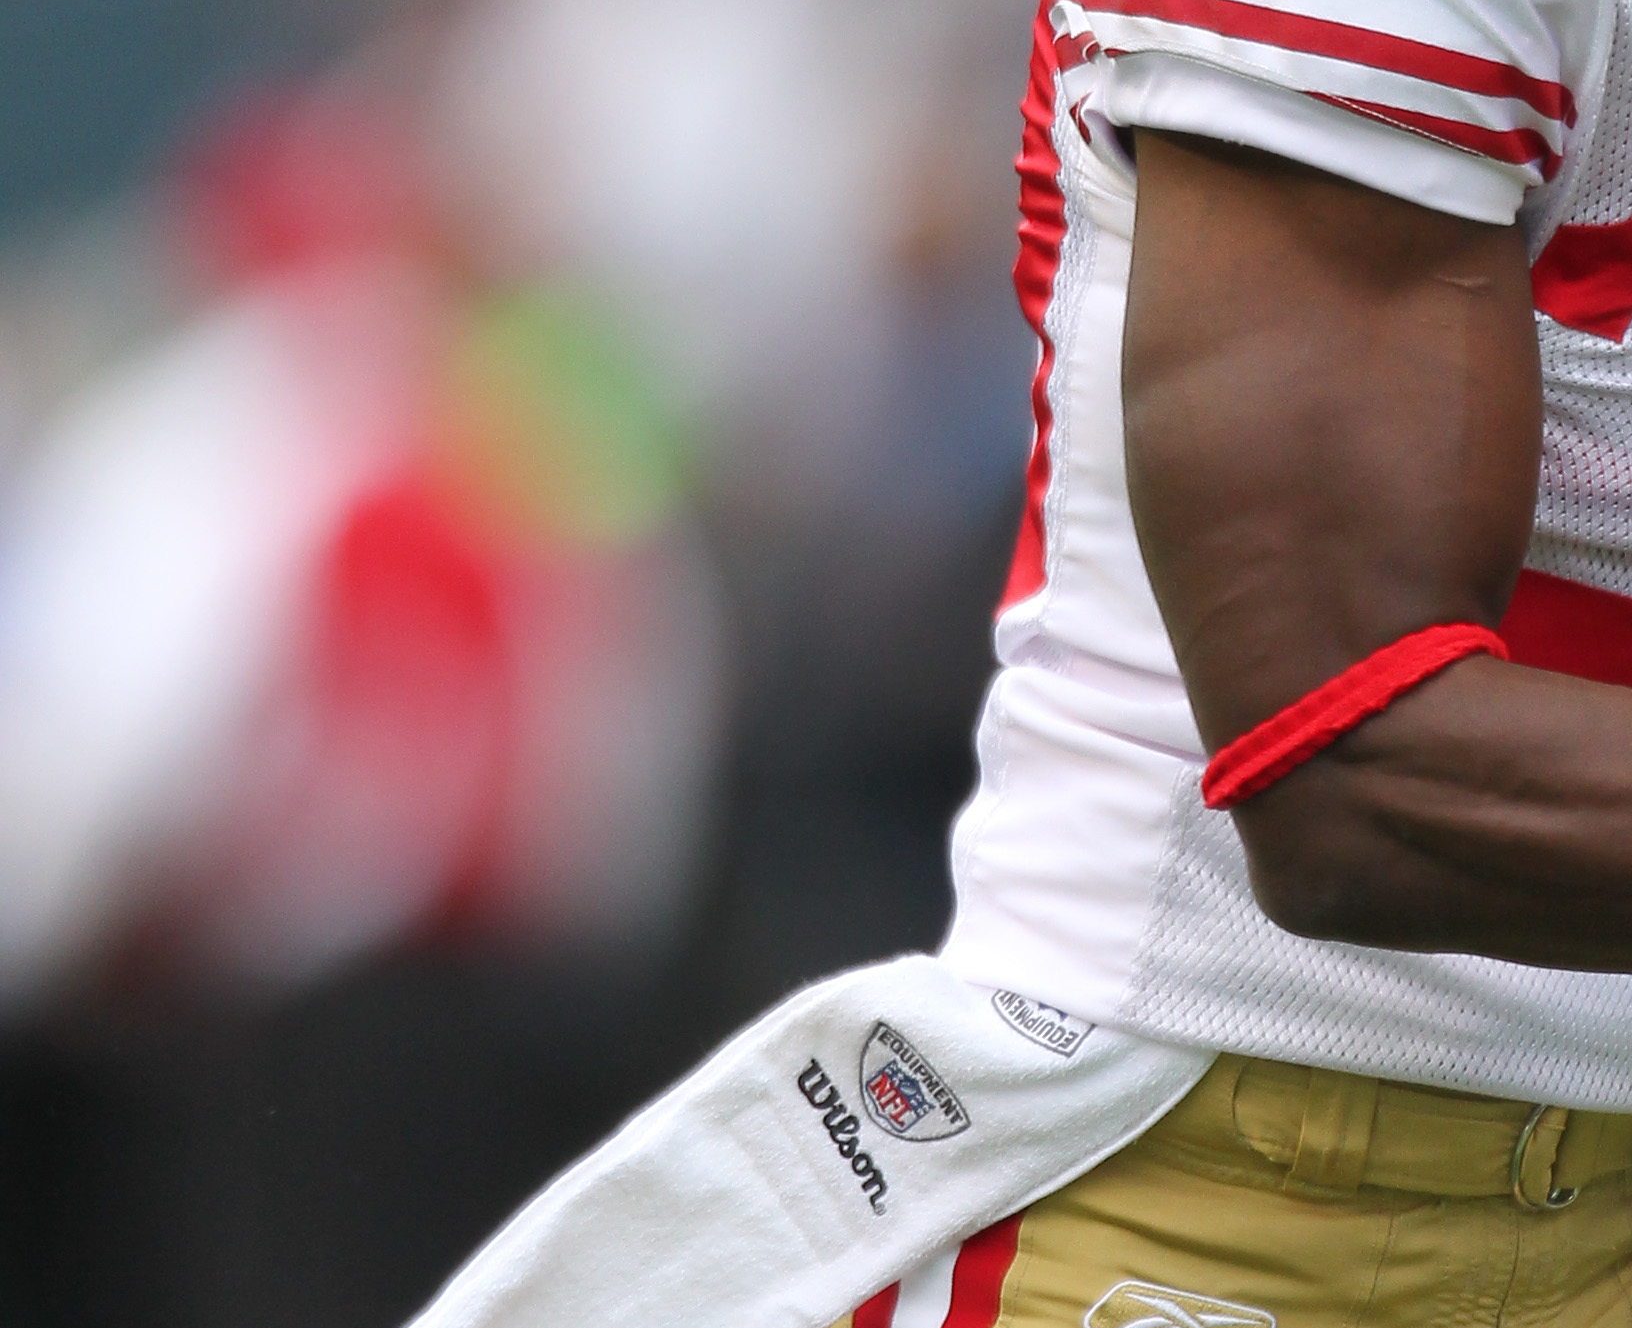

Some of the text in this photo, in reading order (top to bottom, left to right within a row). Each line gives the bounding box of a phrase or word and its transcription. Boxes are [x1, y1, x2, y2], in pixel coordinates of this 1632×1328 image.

[868, 1071, 913, 1128] NFL
[878, 1029, 964, 1125] EQUIPMENT
[798, 1057, 888, 1211] Wilson
